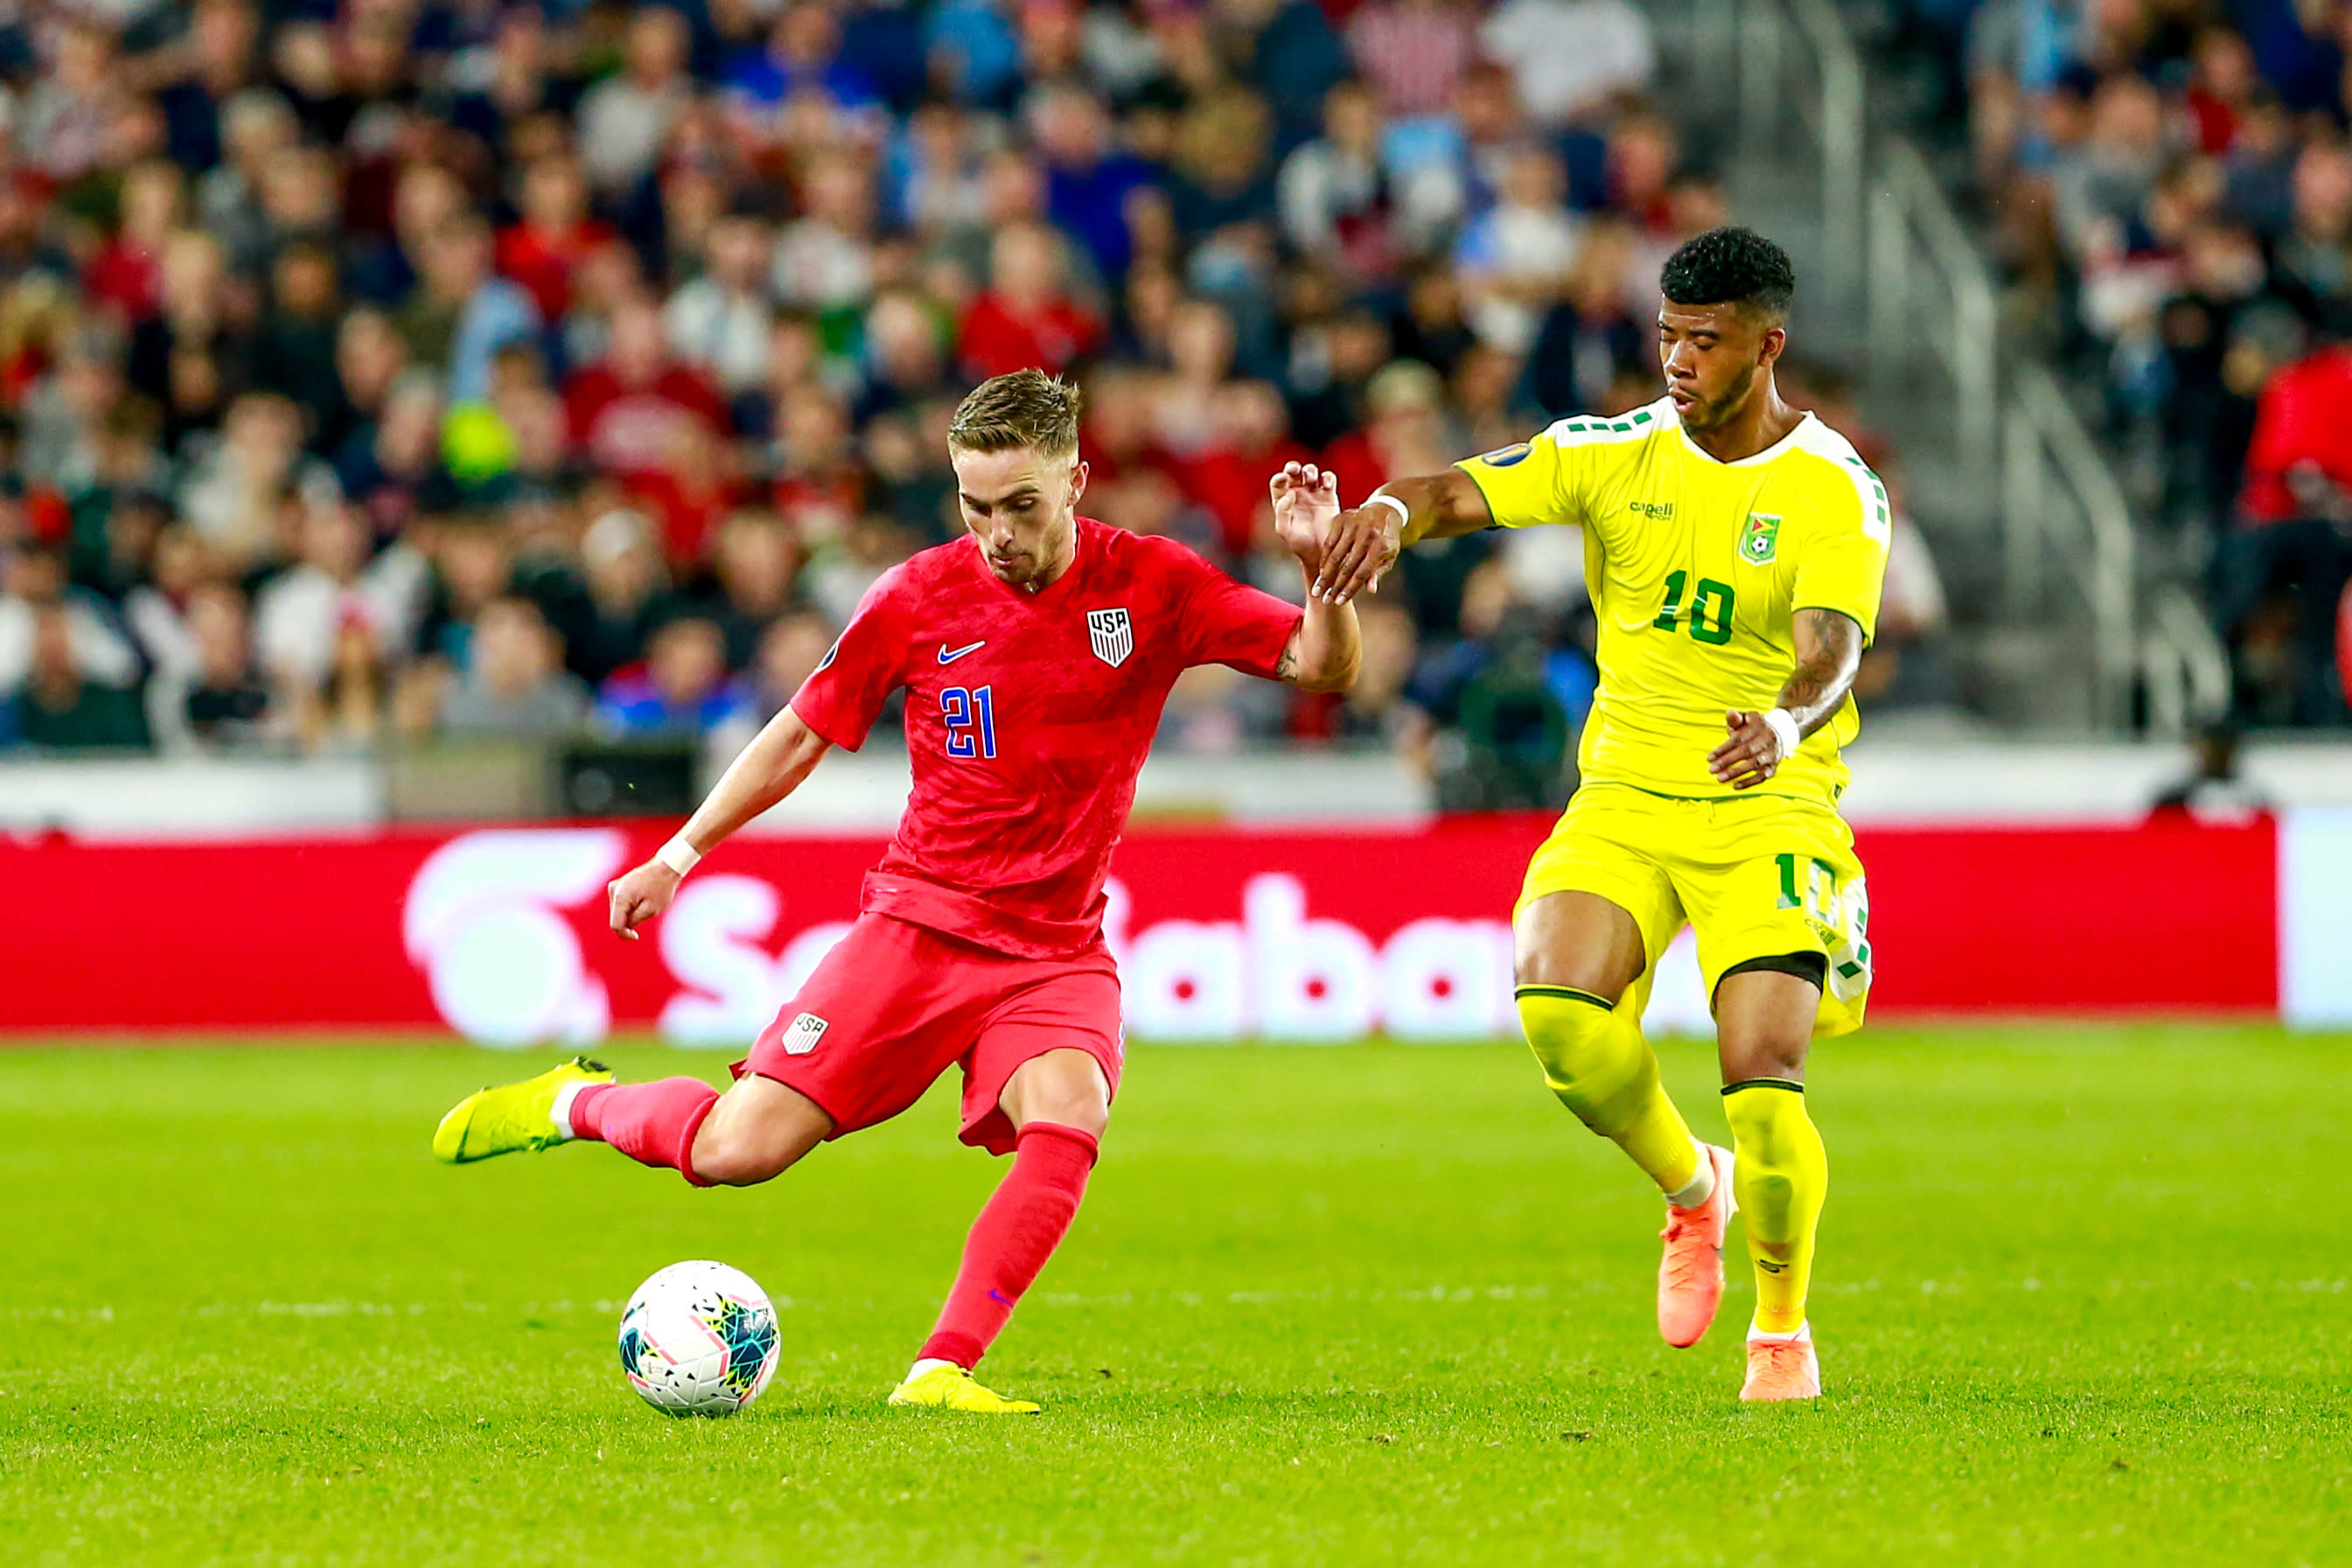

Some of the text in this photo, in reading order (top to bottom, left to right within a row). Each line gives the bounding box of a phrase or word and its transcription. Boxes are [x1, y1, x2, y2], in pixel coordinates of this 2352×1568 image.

[1630, 501, 1673, 516] capell
[1090, 610, 1127, 634] USA
[1653, 569, 1735, 645] 10
[939, 685, 996, 759] 21
[1774, 853, 1838, 927] 10
[797, 1014, 825, 1033] USA
